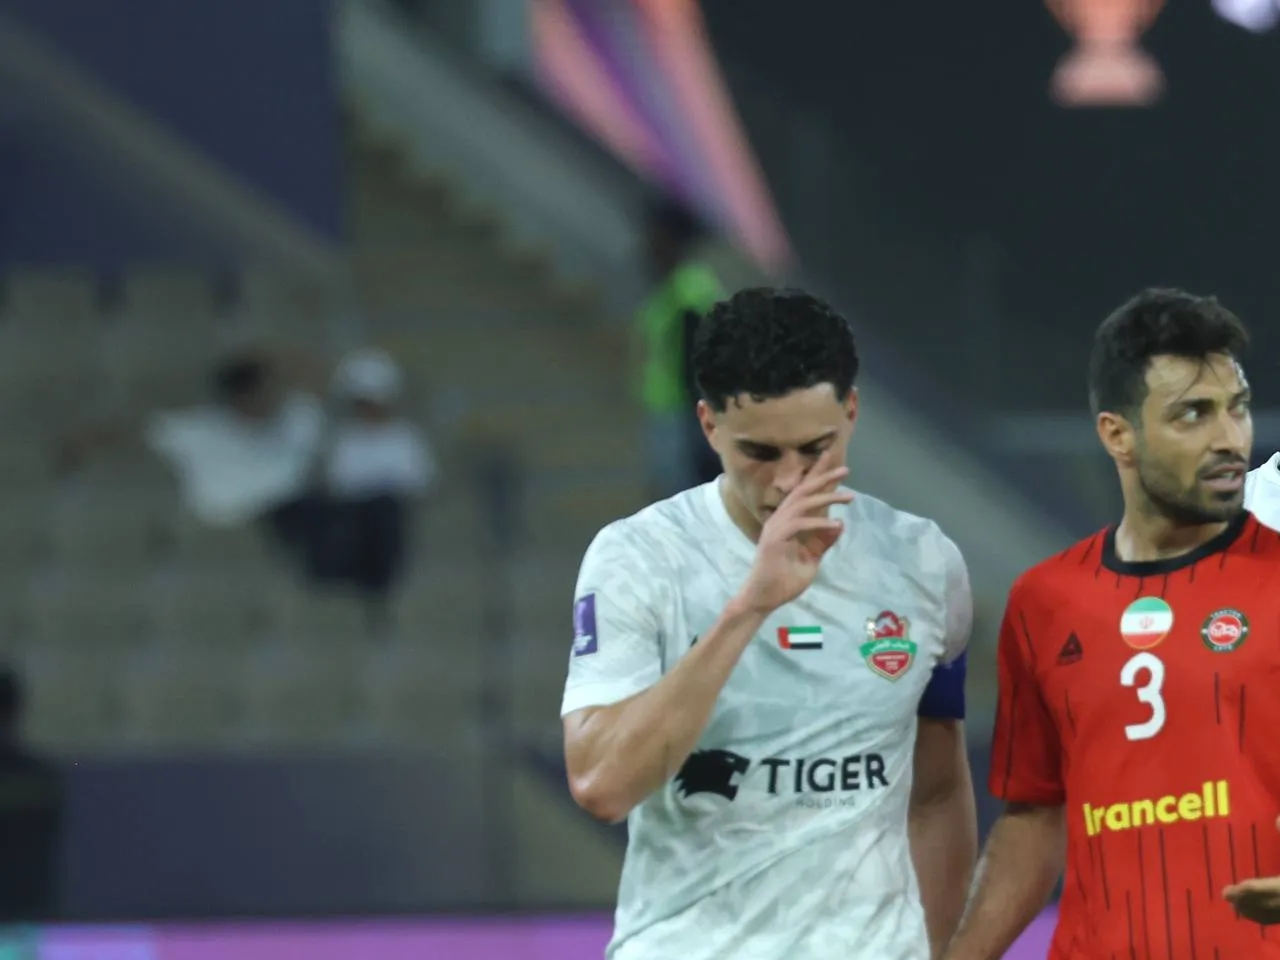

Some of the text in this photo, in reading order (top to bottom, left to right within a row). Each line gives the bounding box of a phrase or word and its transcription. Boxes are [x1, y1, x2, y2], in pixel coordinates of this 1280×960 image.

[1120, 652, 1165, 741] 3
[761, 753, 890, 794] TIGER
[1083, 780, 1229, 836] Irancell
